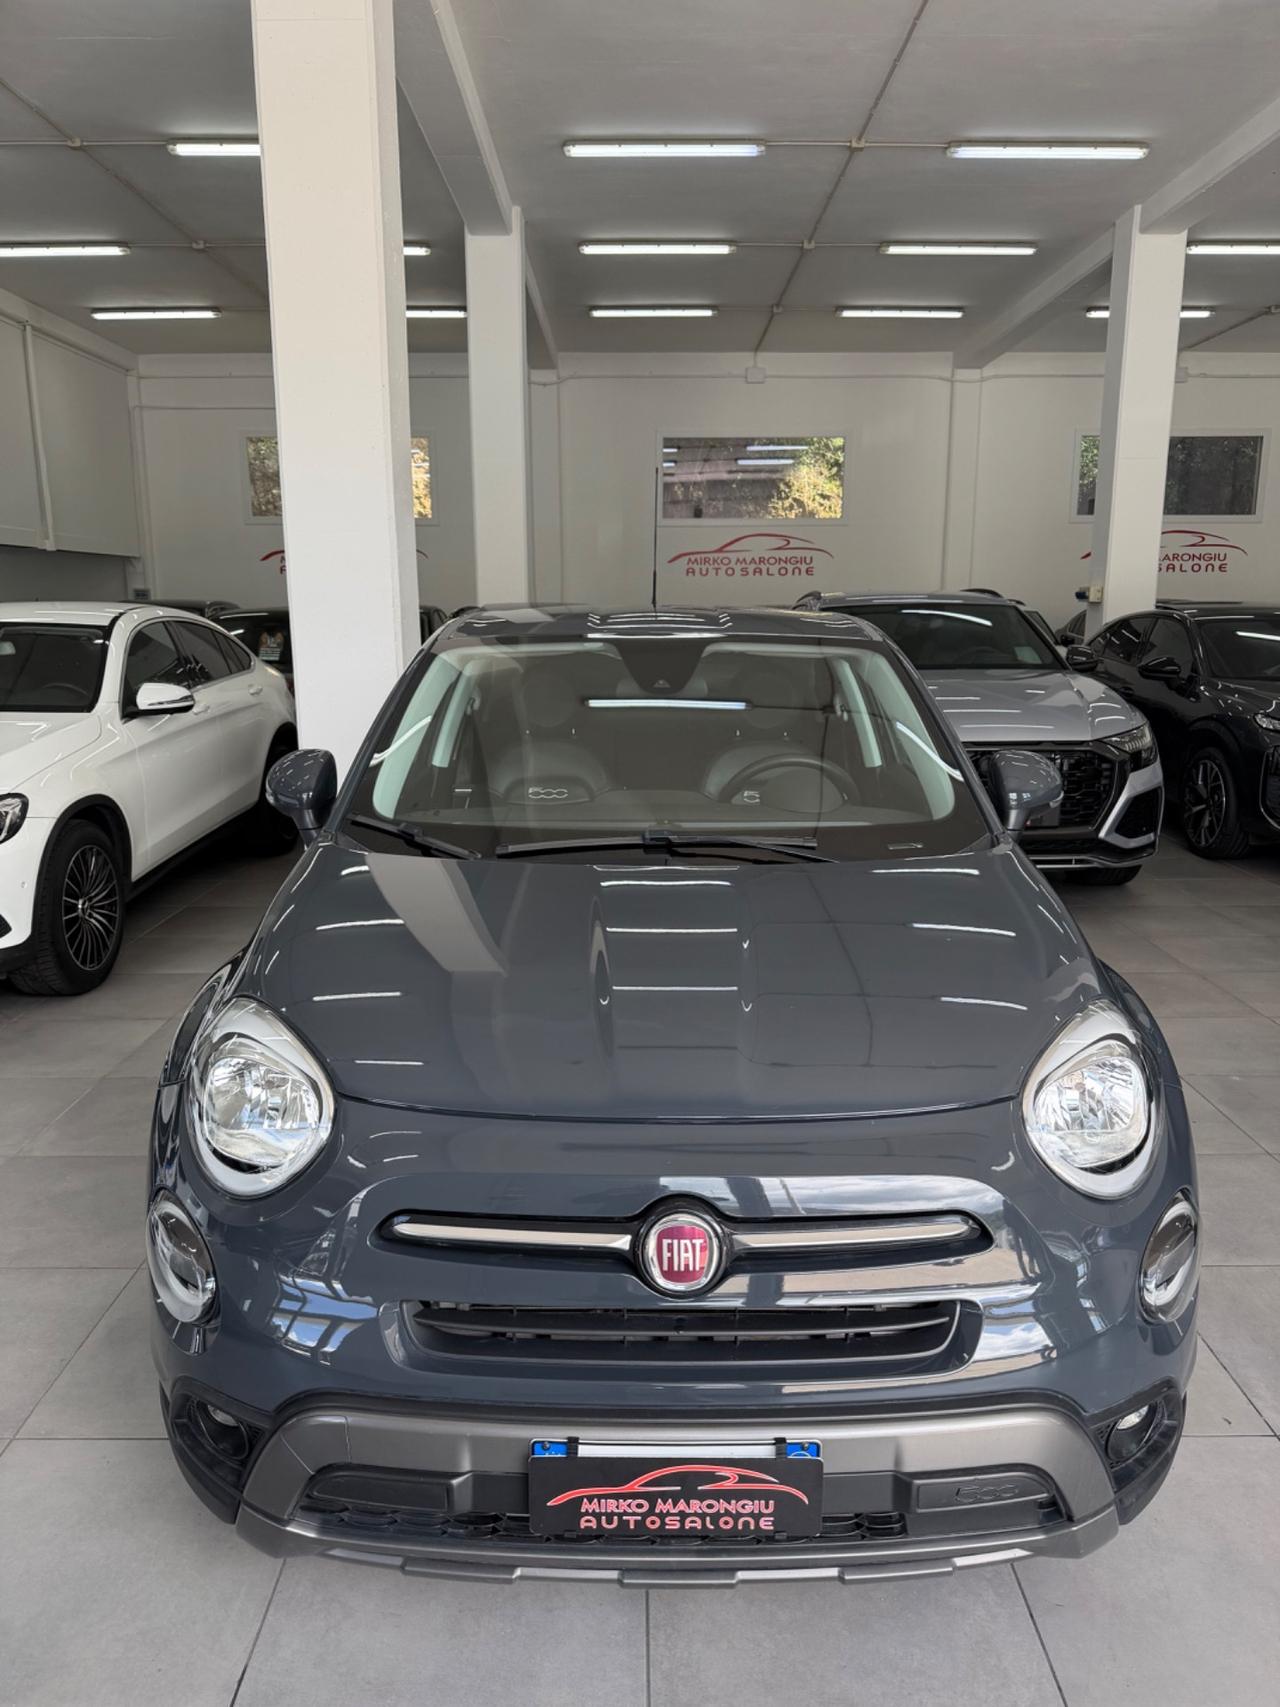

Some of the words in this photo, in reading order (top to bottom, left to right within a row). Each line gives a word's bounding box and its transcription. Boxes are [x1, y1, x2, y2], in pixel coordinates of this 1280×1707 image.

[687, 556, 731, 566] MIRKO
[735, 556, 813, 566] MARONGIU
[1159, 552, 1227, 562] ARONGIU
[686, 566, 815, 577] AUTOSALONE
[661, 1238, 705, 1272] FIAT
[580, 1498, 649, 1514] MIRKO
[655, 1498, 774, 1514] MARONGIU
[580, 1515, 775, 1530] AUTOSALONE
